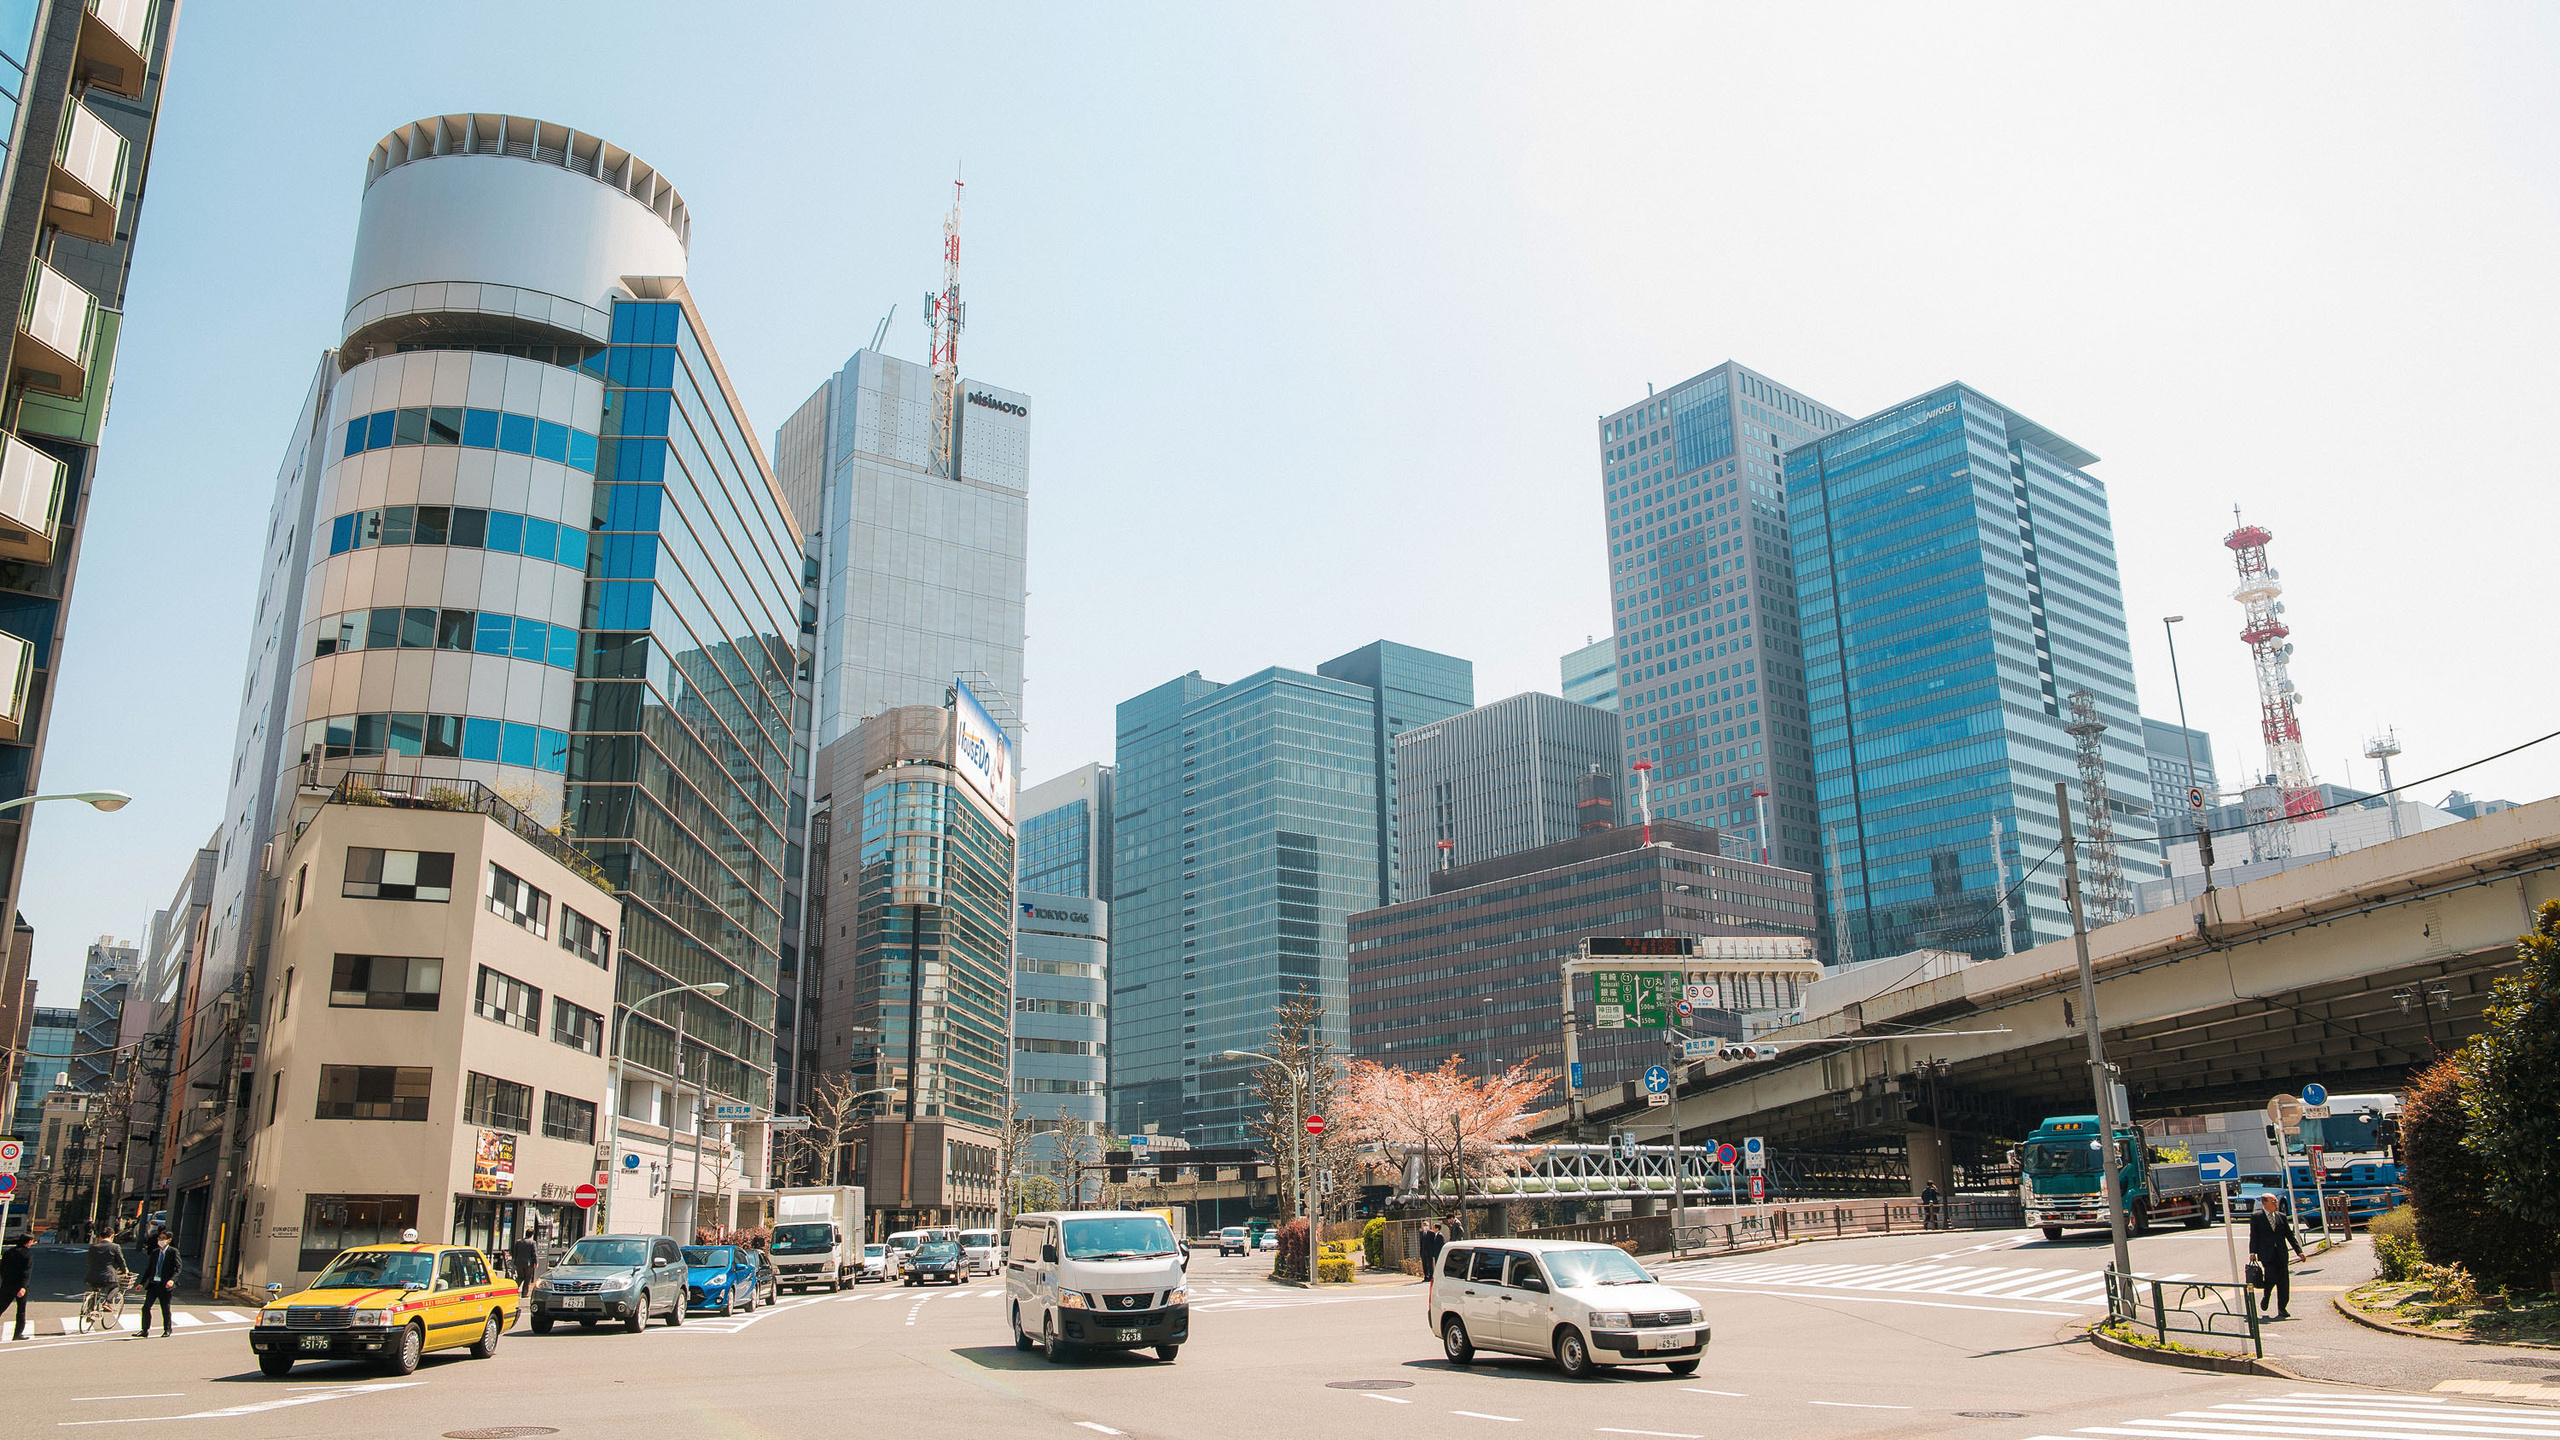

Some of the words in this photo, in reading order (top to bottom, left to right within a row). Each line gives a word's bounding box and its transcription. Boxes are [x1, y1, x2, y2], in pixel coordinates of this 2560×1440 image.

[1926, 401, 1957, 420] NIKKEI
[1400, 730, 1440, 748] KEIDANREN
[1035, 907, 1068, 921] TOKYO
[1070, 911, 1089, 923] GAS
[1655, 977, 1679, 986] 丸内
[5, 1147, 15, 1156] 30
[1122, 1333, 1141, 1341] 26-38
[306, 1340, 328, 1349] 51-75
[1662, 1339, 1680, 1348] 69-61
